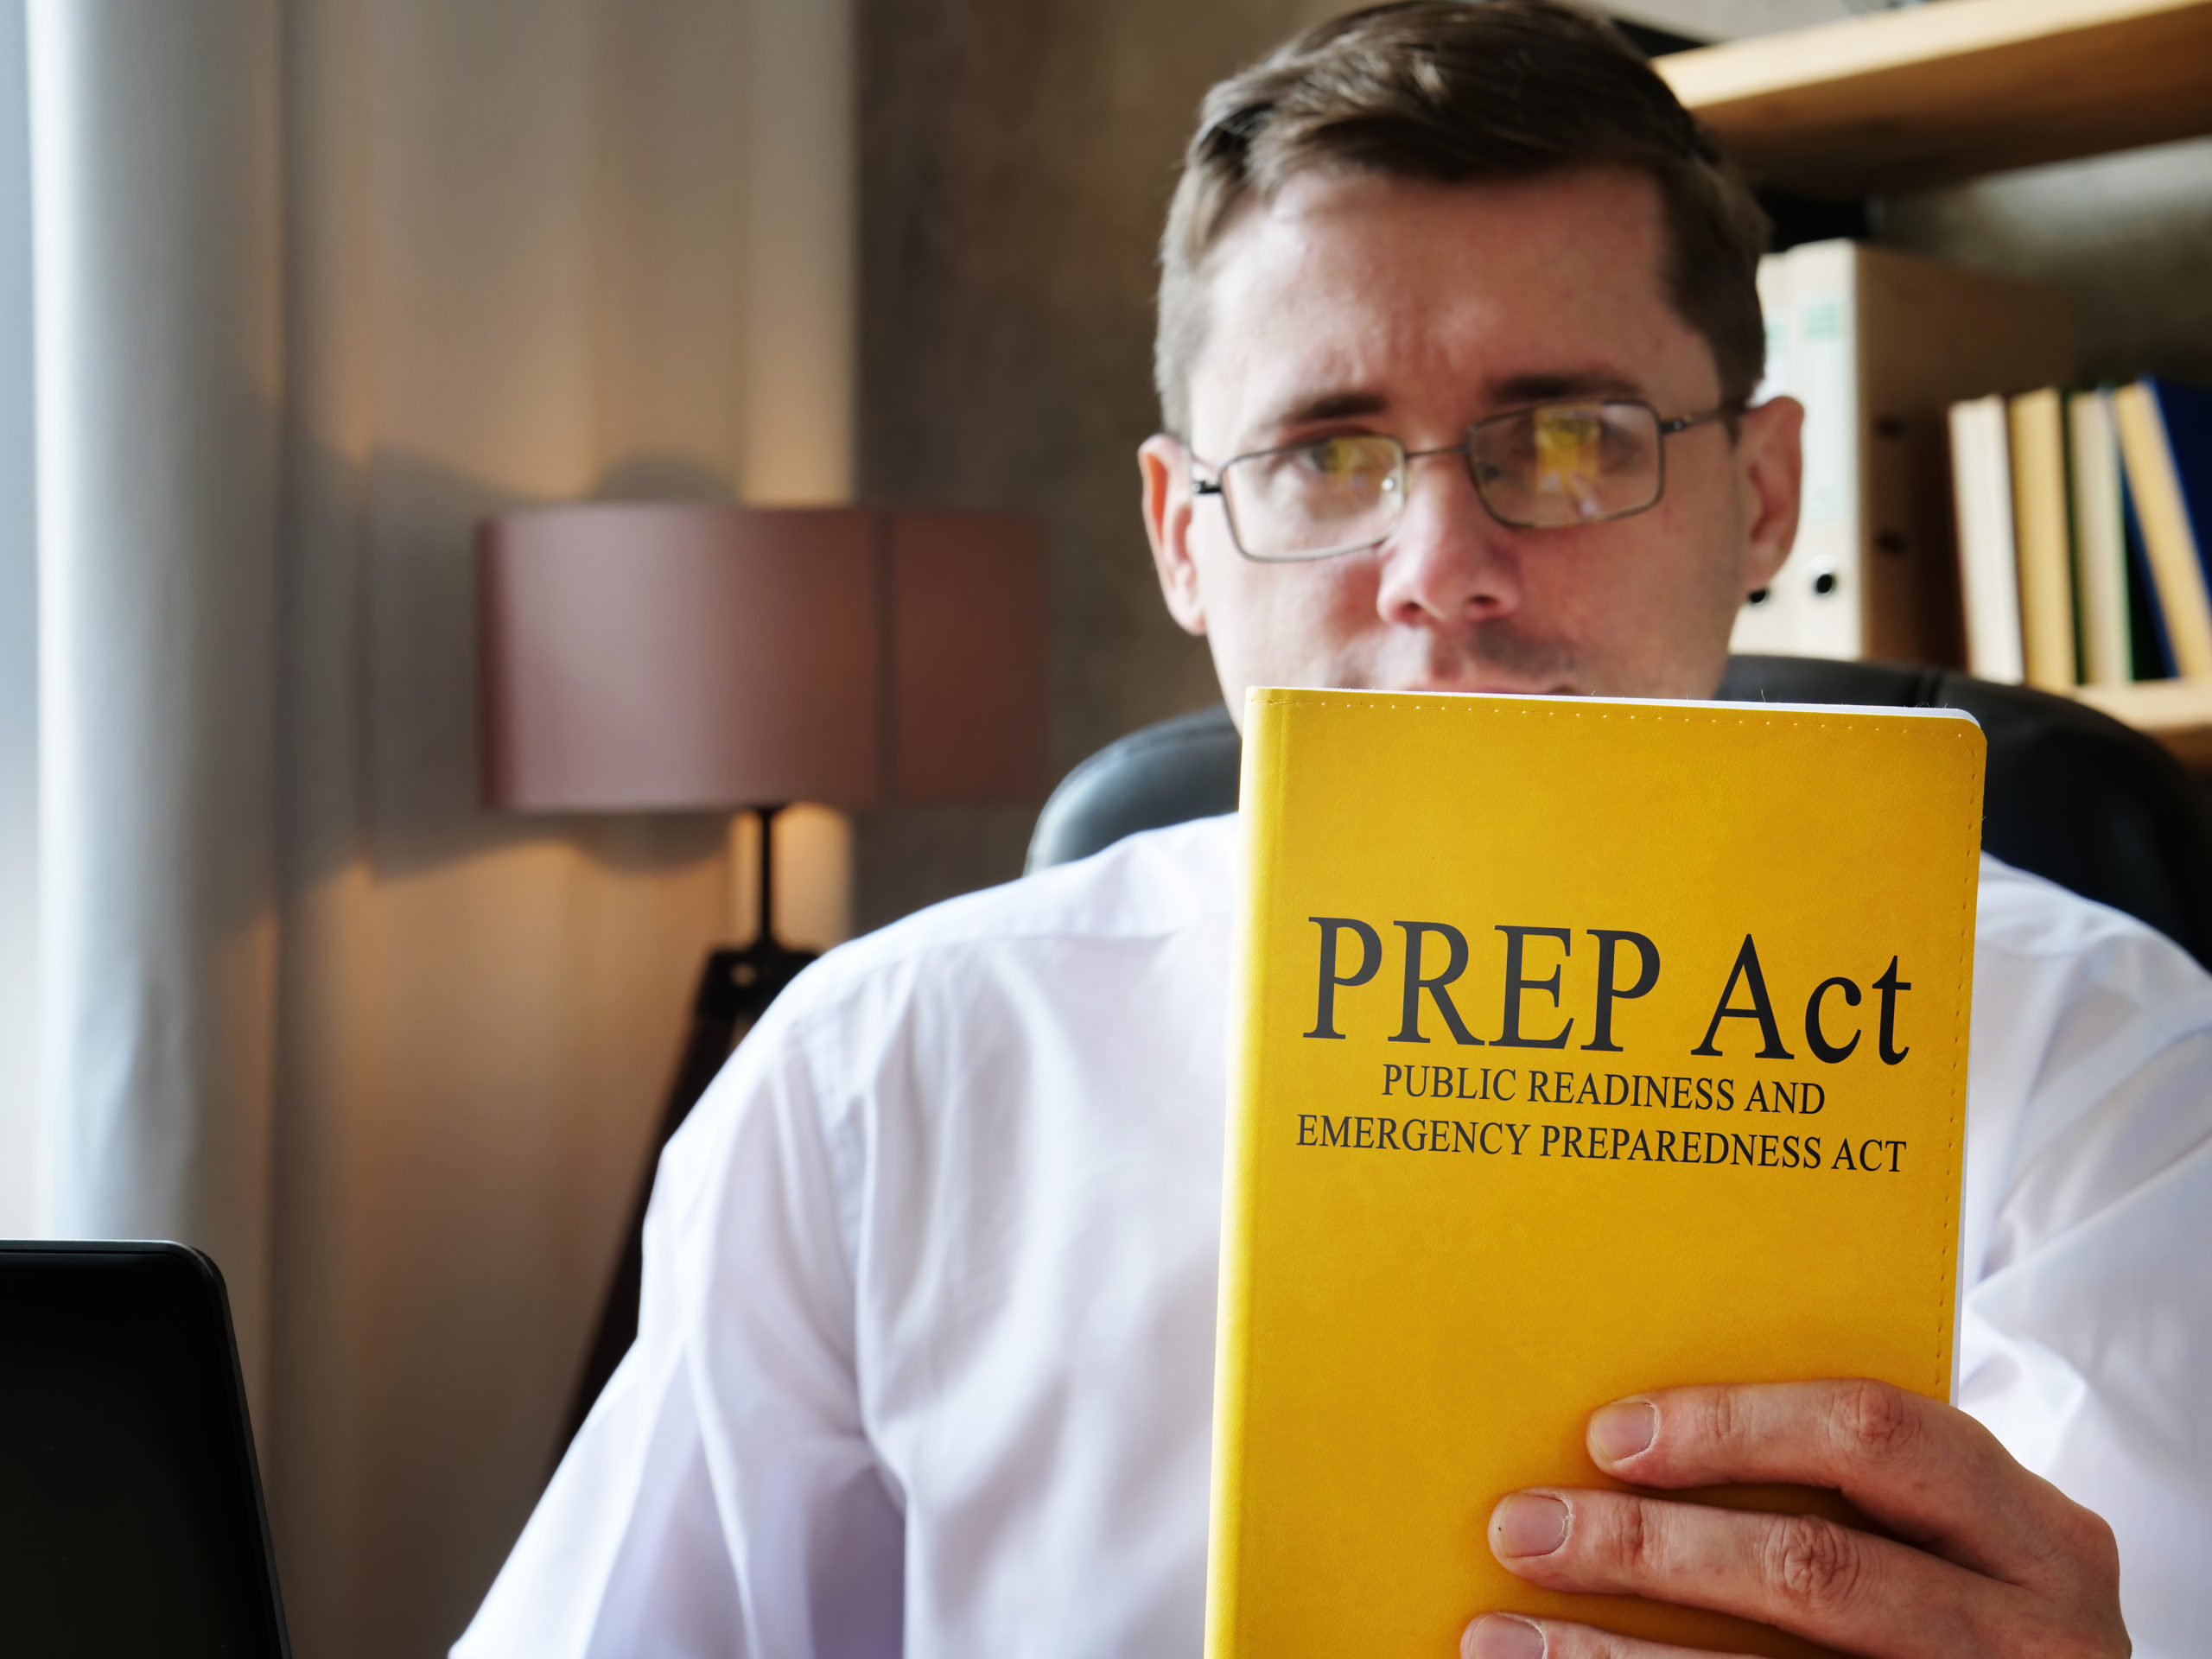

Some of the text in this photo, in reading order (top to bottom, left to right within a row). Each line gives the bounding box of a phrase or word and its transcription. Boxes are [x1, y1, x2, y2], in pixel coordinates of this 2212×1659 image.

[1302, 917, 1912, 1065] PREP Act
[1382, 1064, 1825, 1115] PUBLIC READINESS AND
[1296, 1114, 1907, 1173] EMERGENCY PREPAREDNESS ACT
